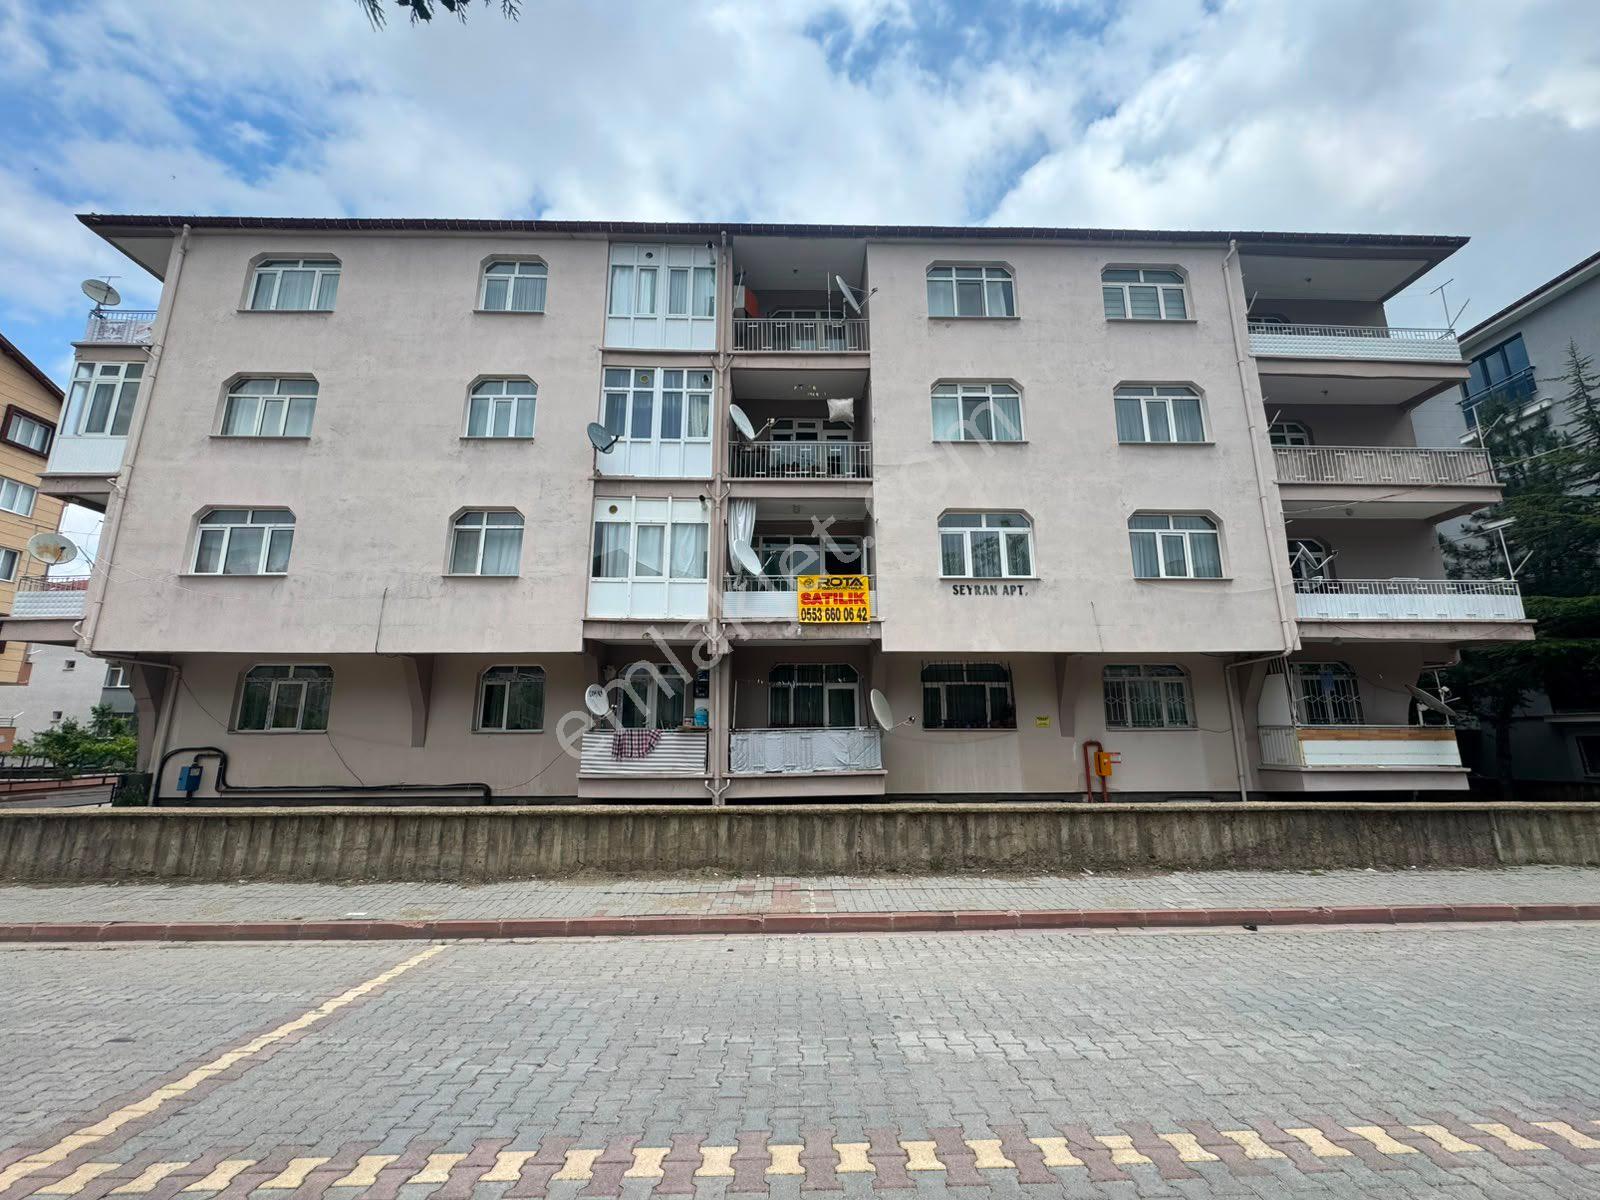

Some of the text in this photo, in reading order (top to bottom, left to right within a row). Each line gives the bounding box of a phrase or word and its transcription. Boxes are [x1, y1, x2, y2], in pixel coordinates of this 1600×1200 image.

[817, 577, 863, 587] ROTA
[952, 584, 998, 596] SEYRAN
[800, 592, 866, 606] SATILIK
[801, 607, 868, 622] 0553 660 06 42
